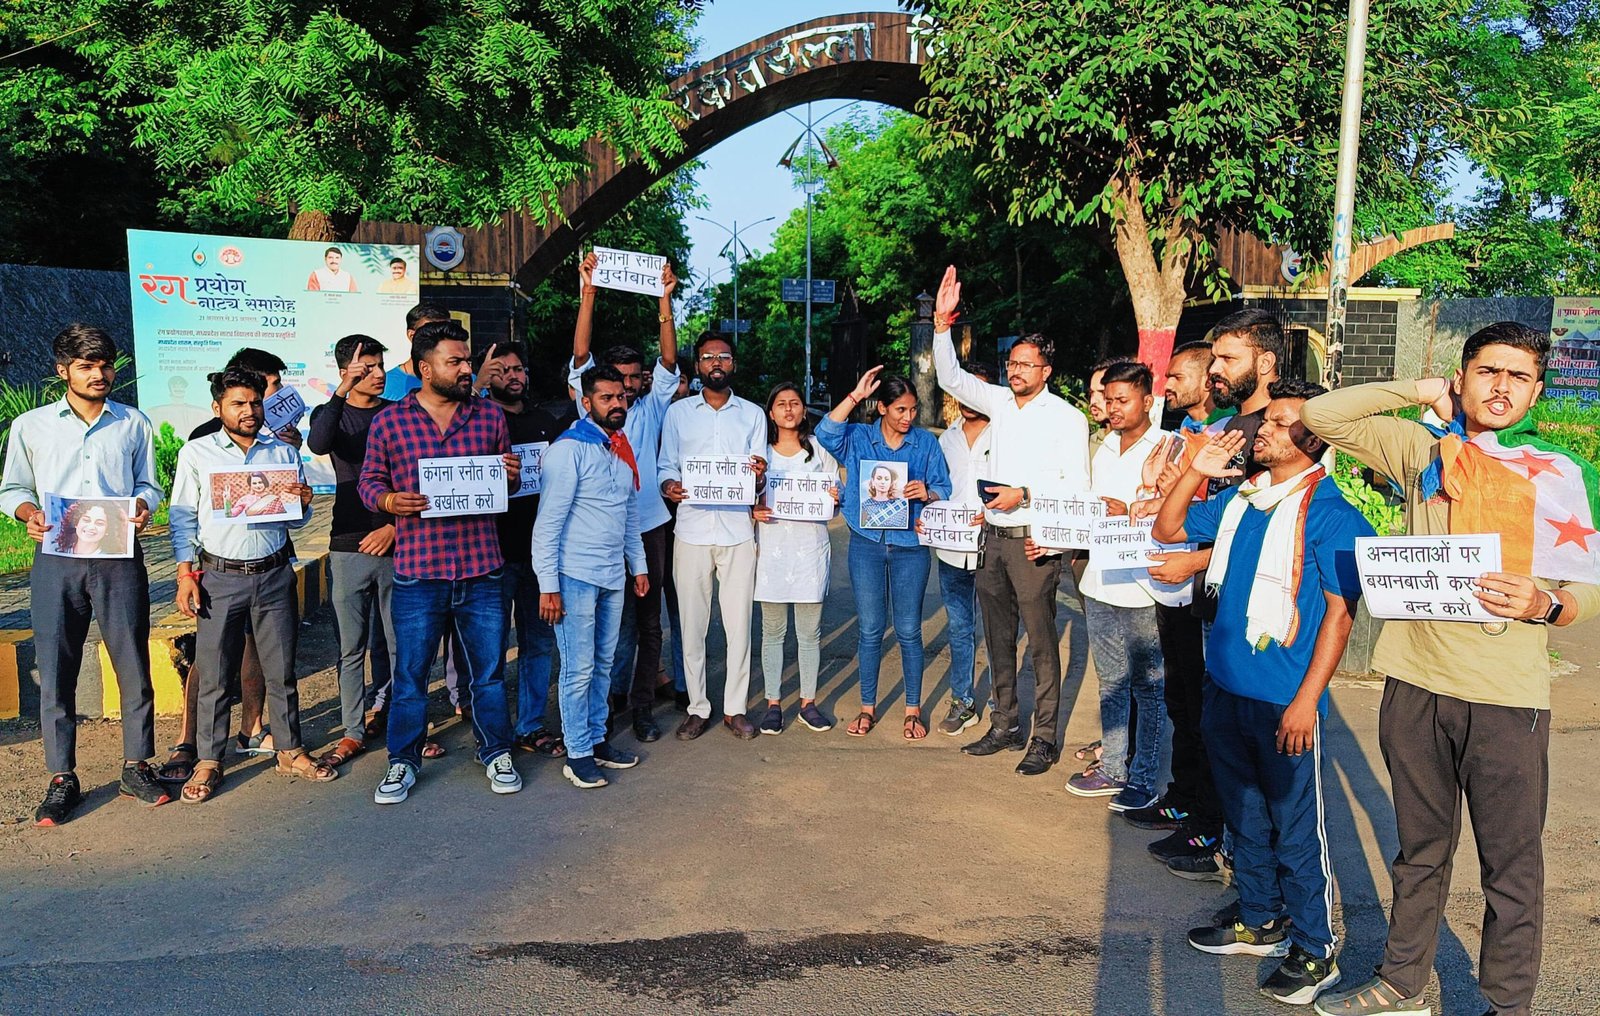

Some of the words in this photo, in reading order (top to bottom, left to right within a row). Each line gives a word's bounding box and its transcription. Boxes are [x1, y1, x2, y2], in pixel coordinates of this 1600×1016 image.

[194, 273, 250, 296] प्रयोग
[598, 267, 658, 288] मुर्दाबाद
[197, 296, 243, 312] नाट्य
[244, 296, 296, 313] समारोह
[261, 315, 296, 328] 2024
[268, 394, 300, 418] रनौत
[423, 462, 453, 482] कंगना
[458, 459, 483, 481] रनौत
[489, 458, 502, 480] को
[686, 457, 711, 474] कंगना
[716, 456, 736, 475] रनौत
[694, 481, 723, 500] बर्खास्त
[727, 482, 744, 500] करो
[770, 473, 793, 491] कंगना
[797, 473, 817, 492] रनौत
[434, 488, 469, 510] बर्खास्त
[474, 488, 494, 509] करो
[777, 497, 804, 515] बर्खास्त
[808, 497, 823, 516] करो
[1034, 493, 1059, 513] कंगना
[1063, 494, 1084, 516] रनौत
[1089, 496, 1102, 517] को
[951, 503, 977, 524] रनौत
[924, 525, 975, 544] मुर्दाबाद
[1042, 521, 1071, 543] बर्खास्त
[1094, 531, 1146, 544] बयानबाजी
[1118, 550, 1138, 561] बन्द
[1367, 540, 1450, 563] अन्नदाताओं
[1459, 546, 1481, 563] पर
[1364, 570, 1439, 590] बयानबाजी
[1403, 601, 1433, 615] बन्द
[1440, 597, 1471, 616] करो
